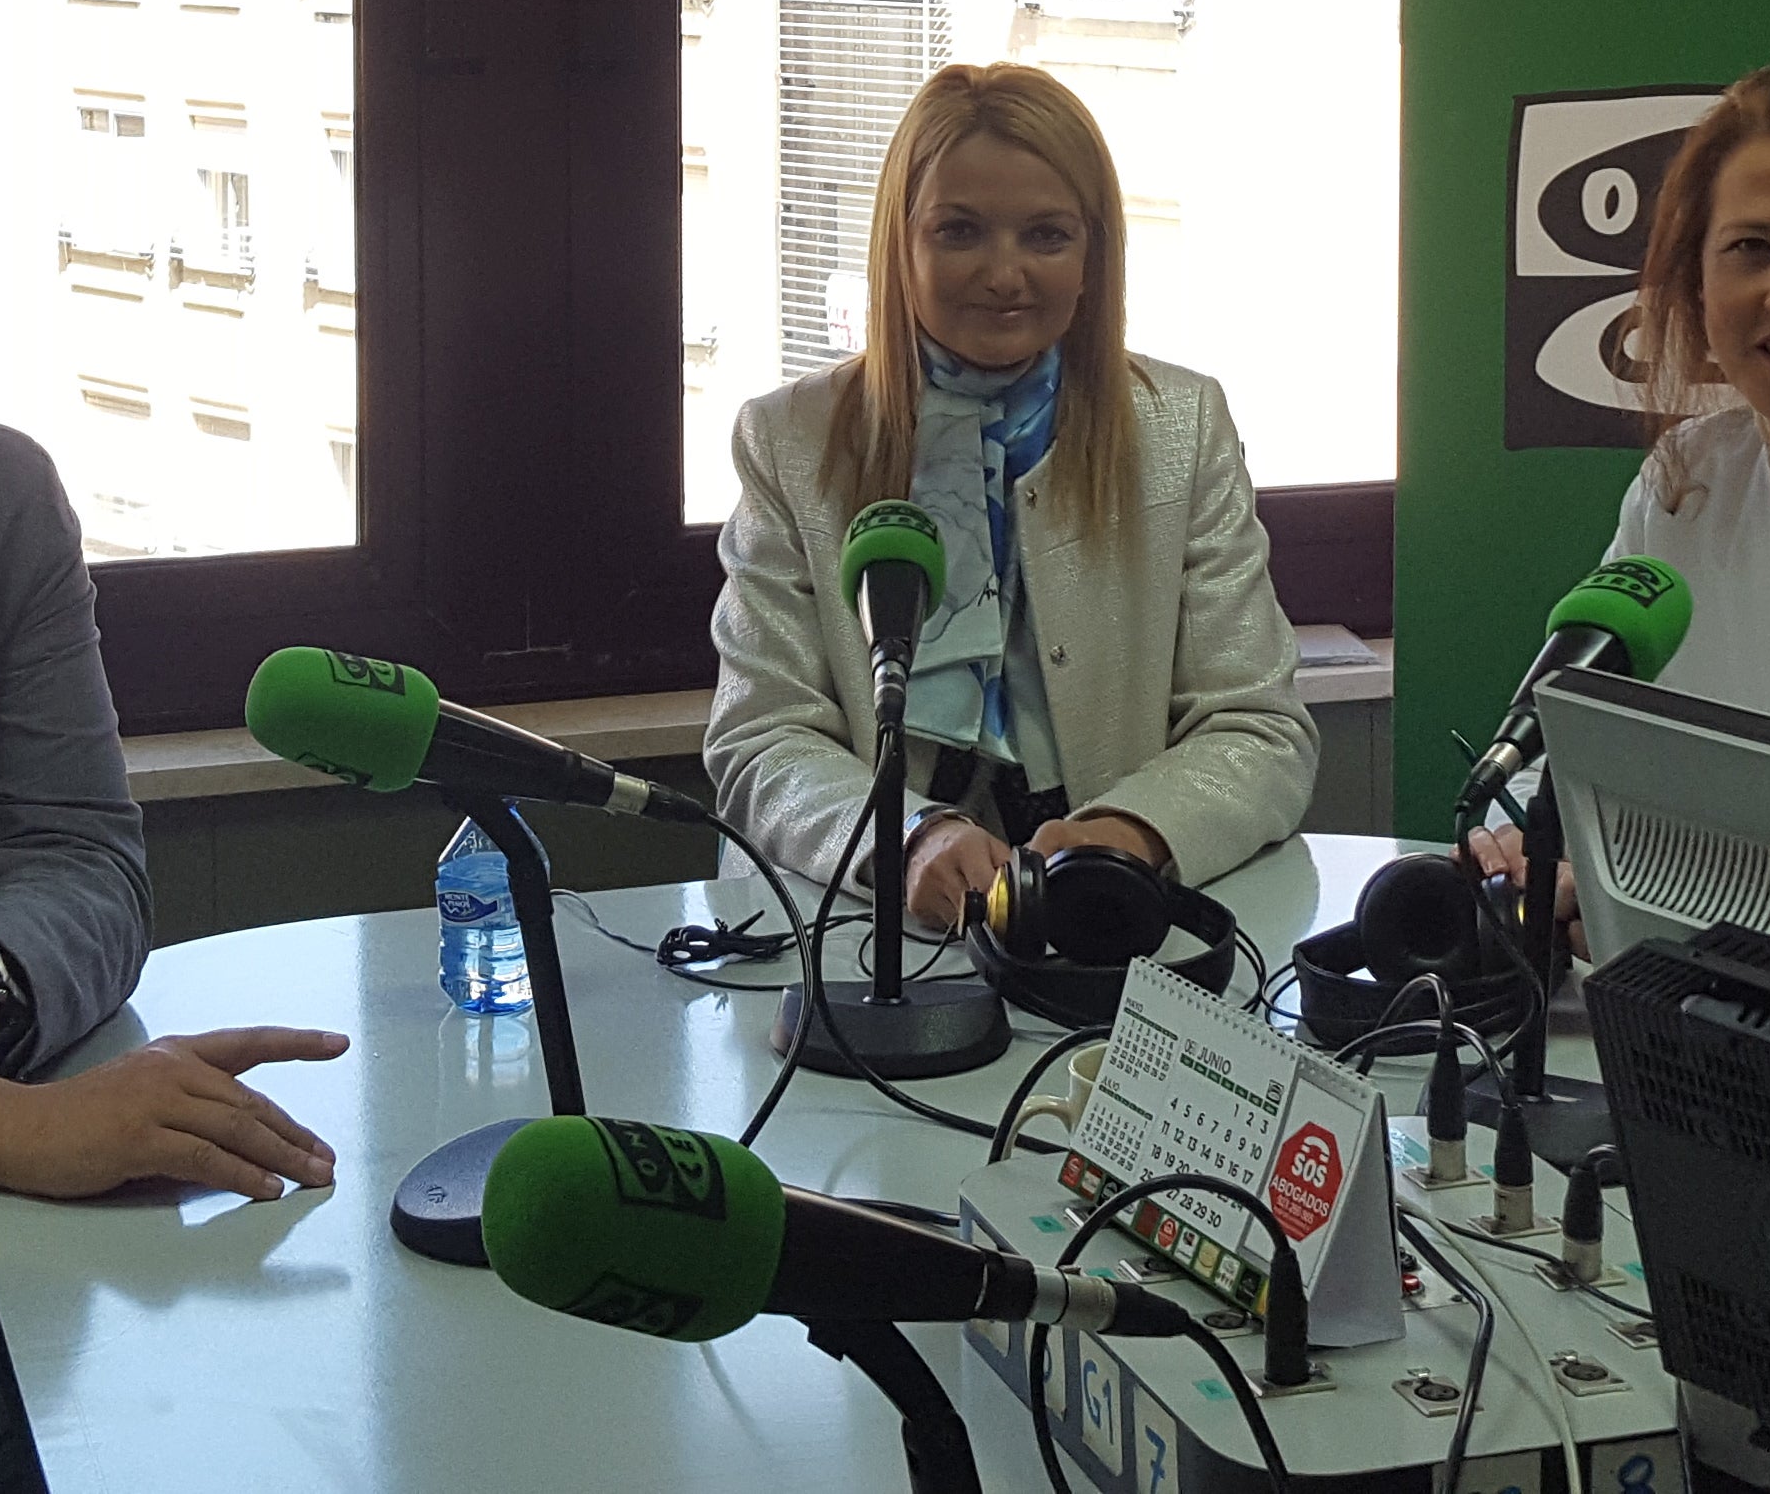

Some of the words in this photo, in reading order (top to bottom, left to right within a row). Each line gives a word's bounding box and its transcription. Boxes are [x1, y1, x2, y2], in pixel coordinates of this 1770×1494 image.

[1197, 1046, 1232, 1075] JUNIO
[1170, 1097, 1179, 1111] 4
[1183, 1104, 1192, 1118] 5
[1197, 1112, 1205, 1126] 6
[1210, 1120, 1219, 1134] 7
[1224, 1129, 1232, 1143] 8
[1237, 1137, 1246, 1151] 9
[1249, 1142, 1263, 1161] 10
[1234, 1103, 1240, 1117] 1
[1246, 1112, 1254, 1127] 2
[1260, 1120, 1269, 1135] 3
[1151, 1143, 1162, 1159] 18
[1164, 1151, 1176, 1168] 19
[1161, 1120, 1171, 1136] 11
[1173, 1127, 1185, 1145] 12
[1187, 1136, 1198, 1152] 13
[1200, 1144, 1212, 1161] 14
[1214, 1152, 1226, 1169] 15
[1227, 1160, 1240, 1177] 16
[1241, 1168, 1254, 1185] 17
[1291, 1152, 1328, 1188] SOS
[1179, 1194, 1194, 1211] 28
[1193, 1202, 1208, 1220] 29
[1206, 1210, 1222, 1228] 30
[1270, 1174, 1330, 1217] ABOGADOS
[1083, 1359, 1114, 1446] G1
